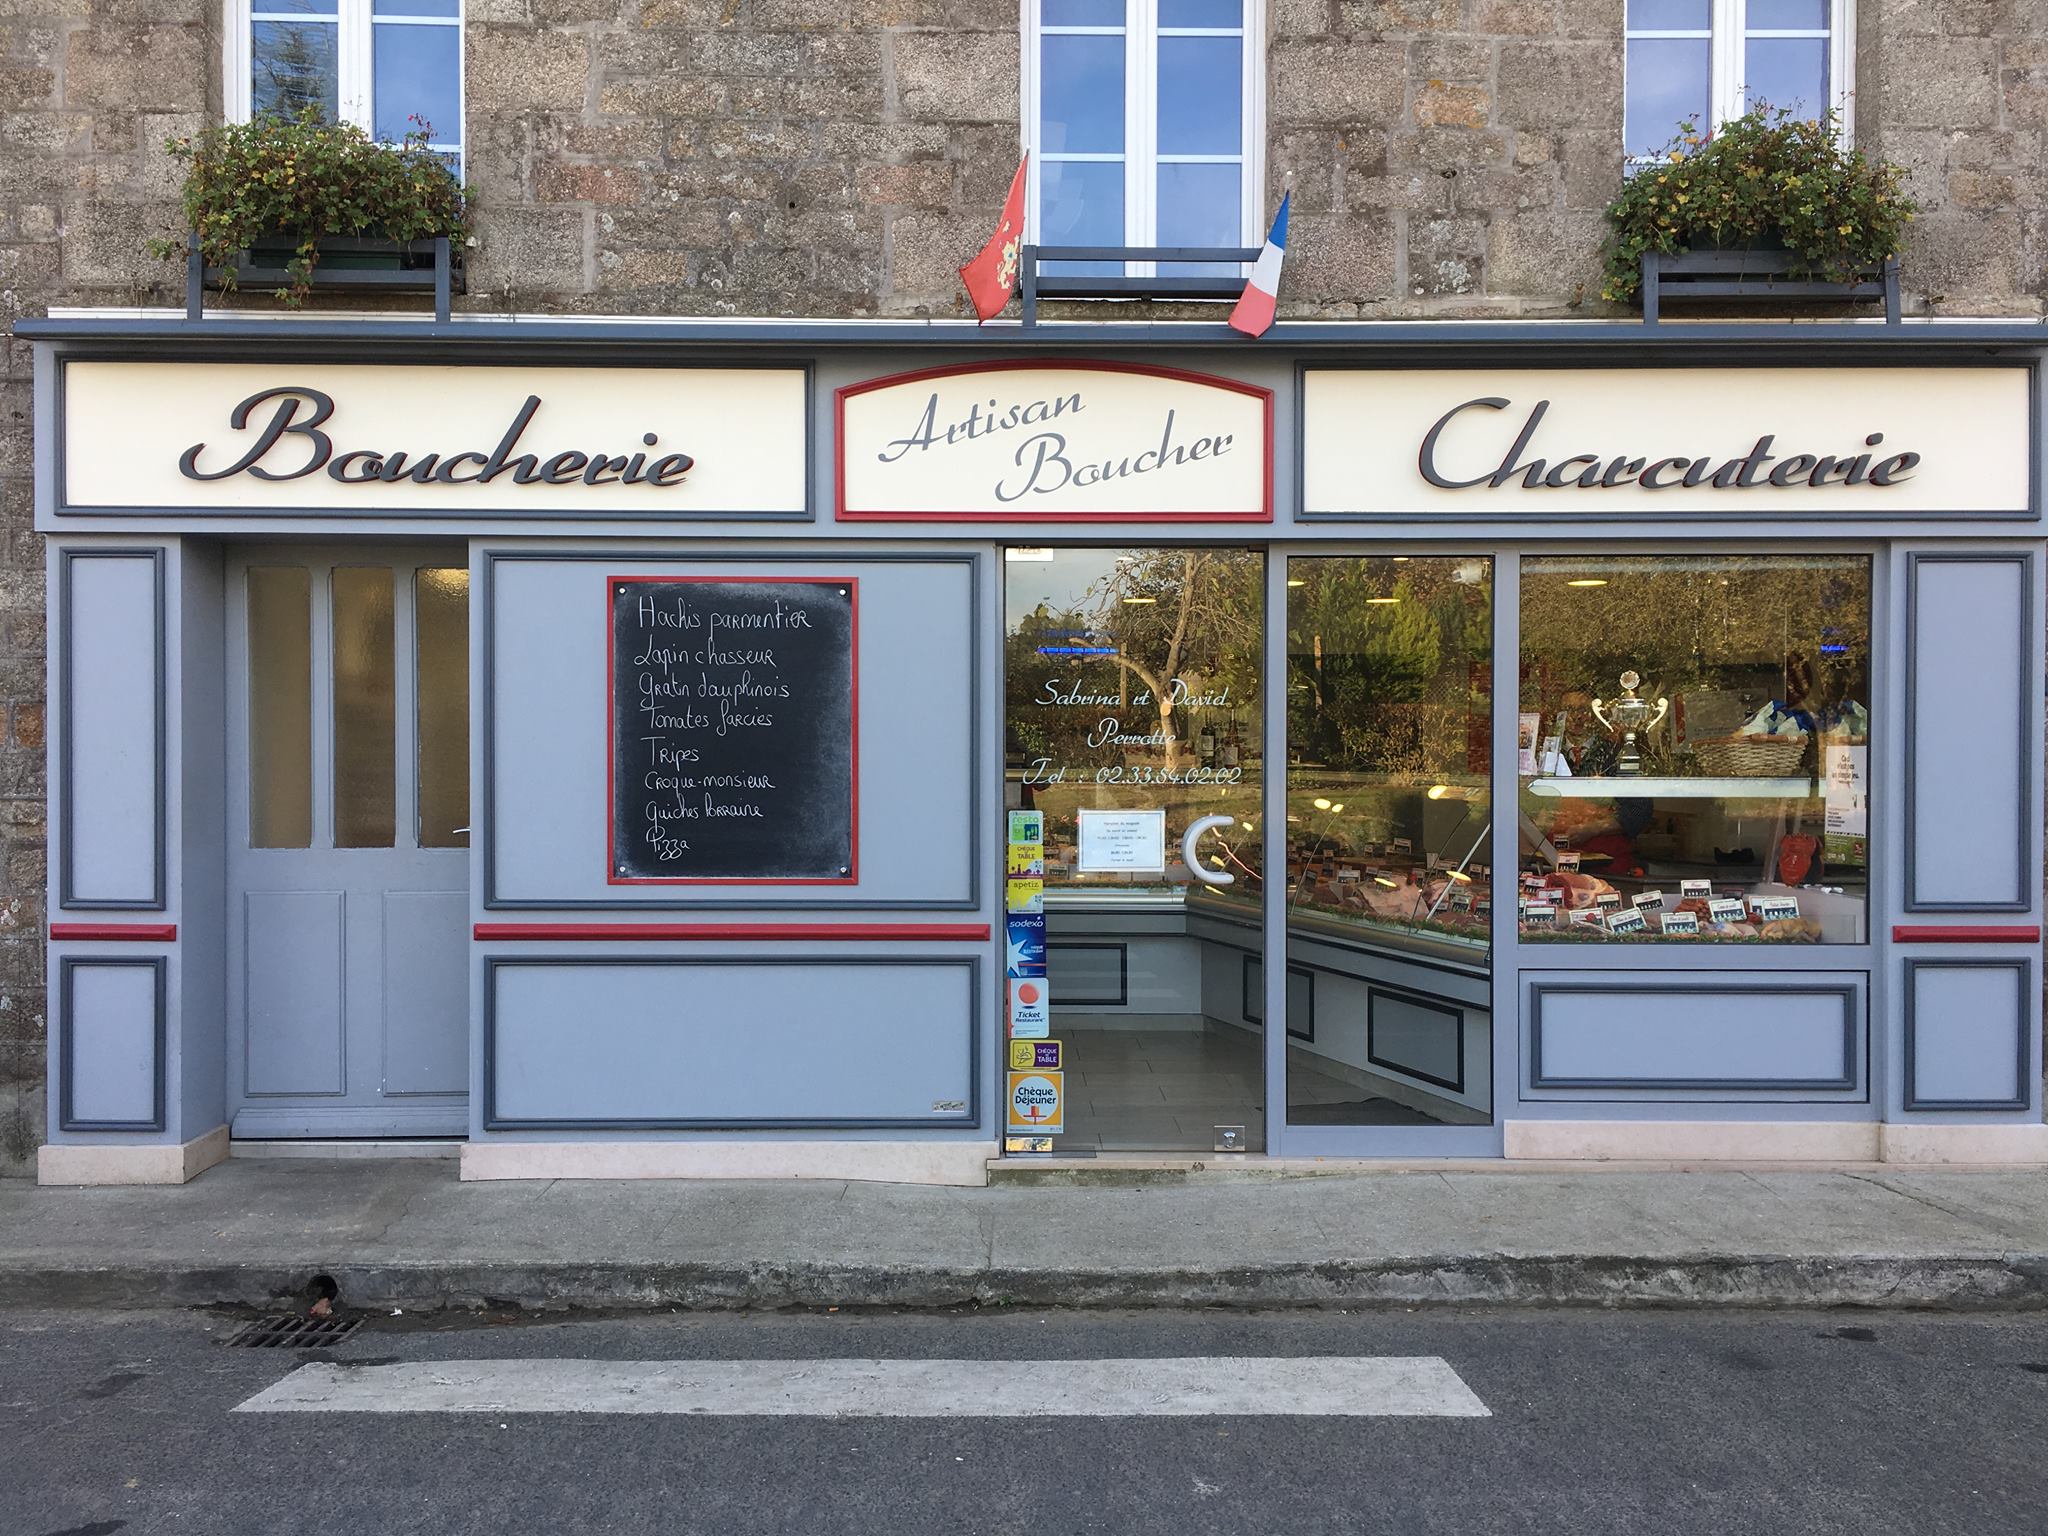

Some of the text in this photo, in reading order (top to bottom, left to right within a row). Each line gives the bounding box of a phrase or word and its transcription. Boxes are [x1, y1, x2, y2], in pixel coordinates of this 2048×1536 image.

[179, 386, 693, 486] Boucherie
[878, 393, 1086, 463] Artisan
[1418, 396, 1921, 490] Charcuterie
[995, 409, 1233, 502] Boucher
[639, 595, 812, 641] Hachis parmentier
[633, 634, 776, 675] Lapin chasseur
[698, 670, 790, 706] dauphinois
[1035, 679, 1229, 705] Sabrina et David
[640, 699, 773, 736] Tomates farcies
[640, 736, 700, 771] Tripes
[1022, 758, 1065, 784] Tel
[645, 771, 776, 795] Croque-monsieur
[646, 826, 690, 860] Pizza
[1009, 916, 1044, 928] sodexo
[1015, 1095, 1056, 1106] Déjeuner
[1018, 1087, 1053, 1097] Chèque
